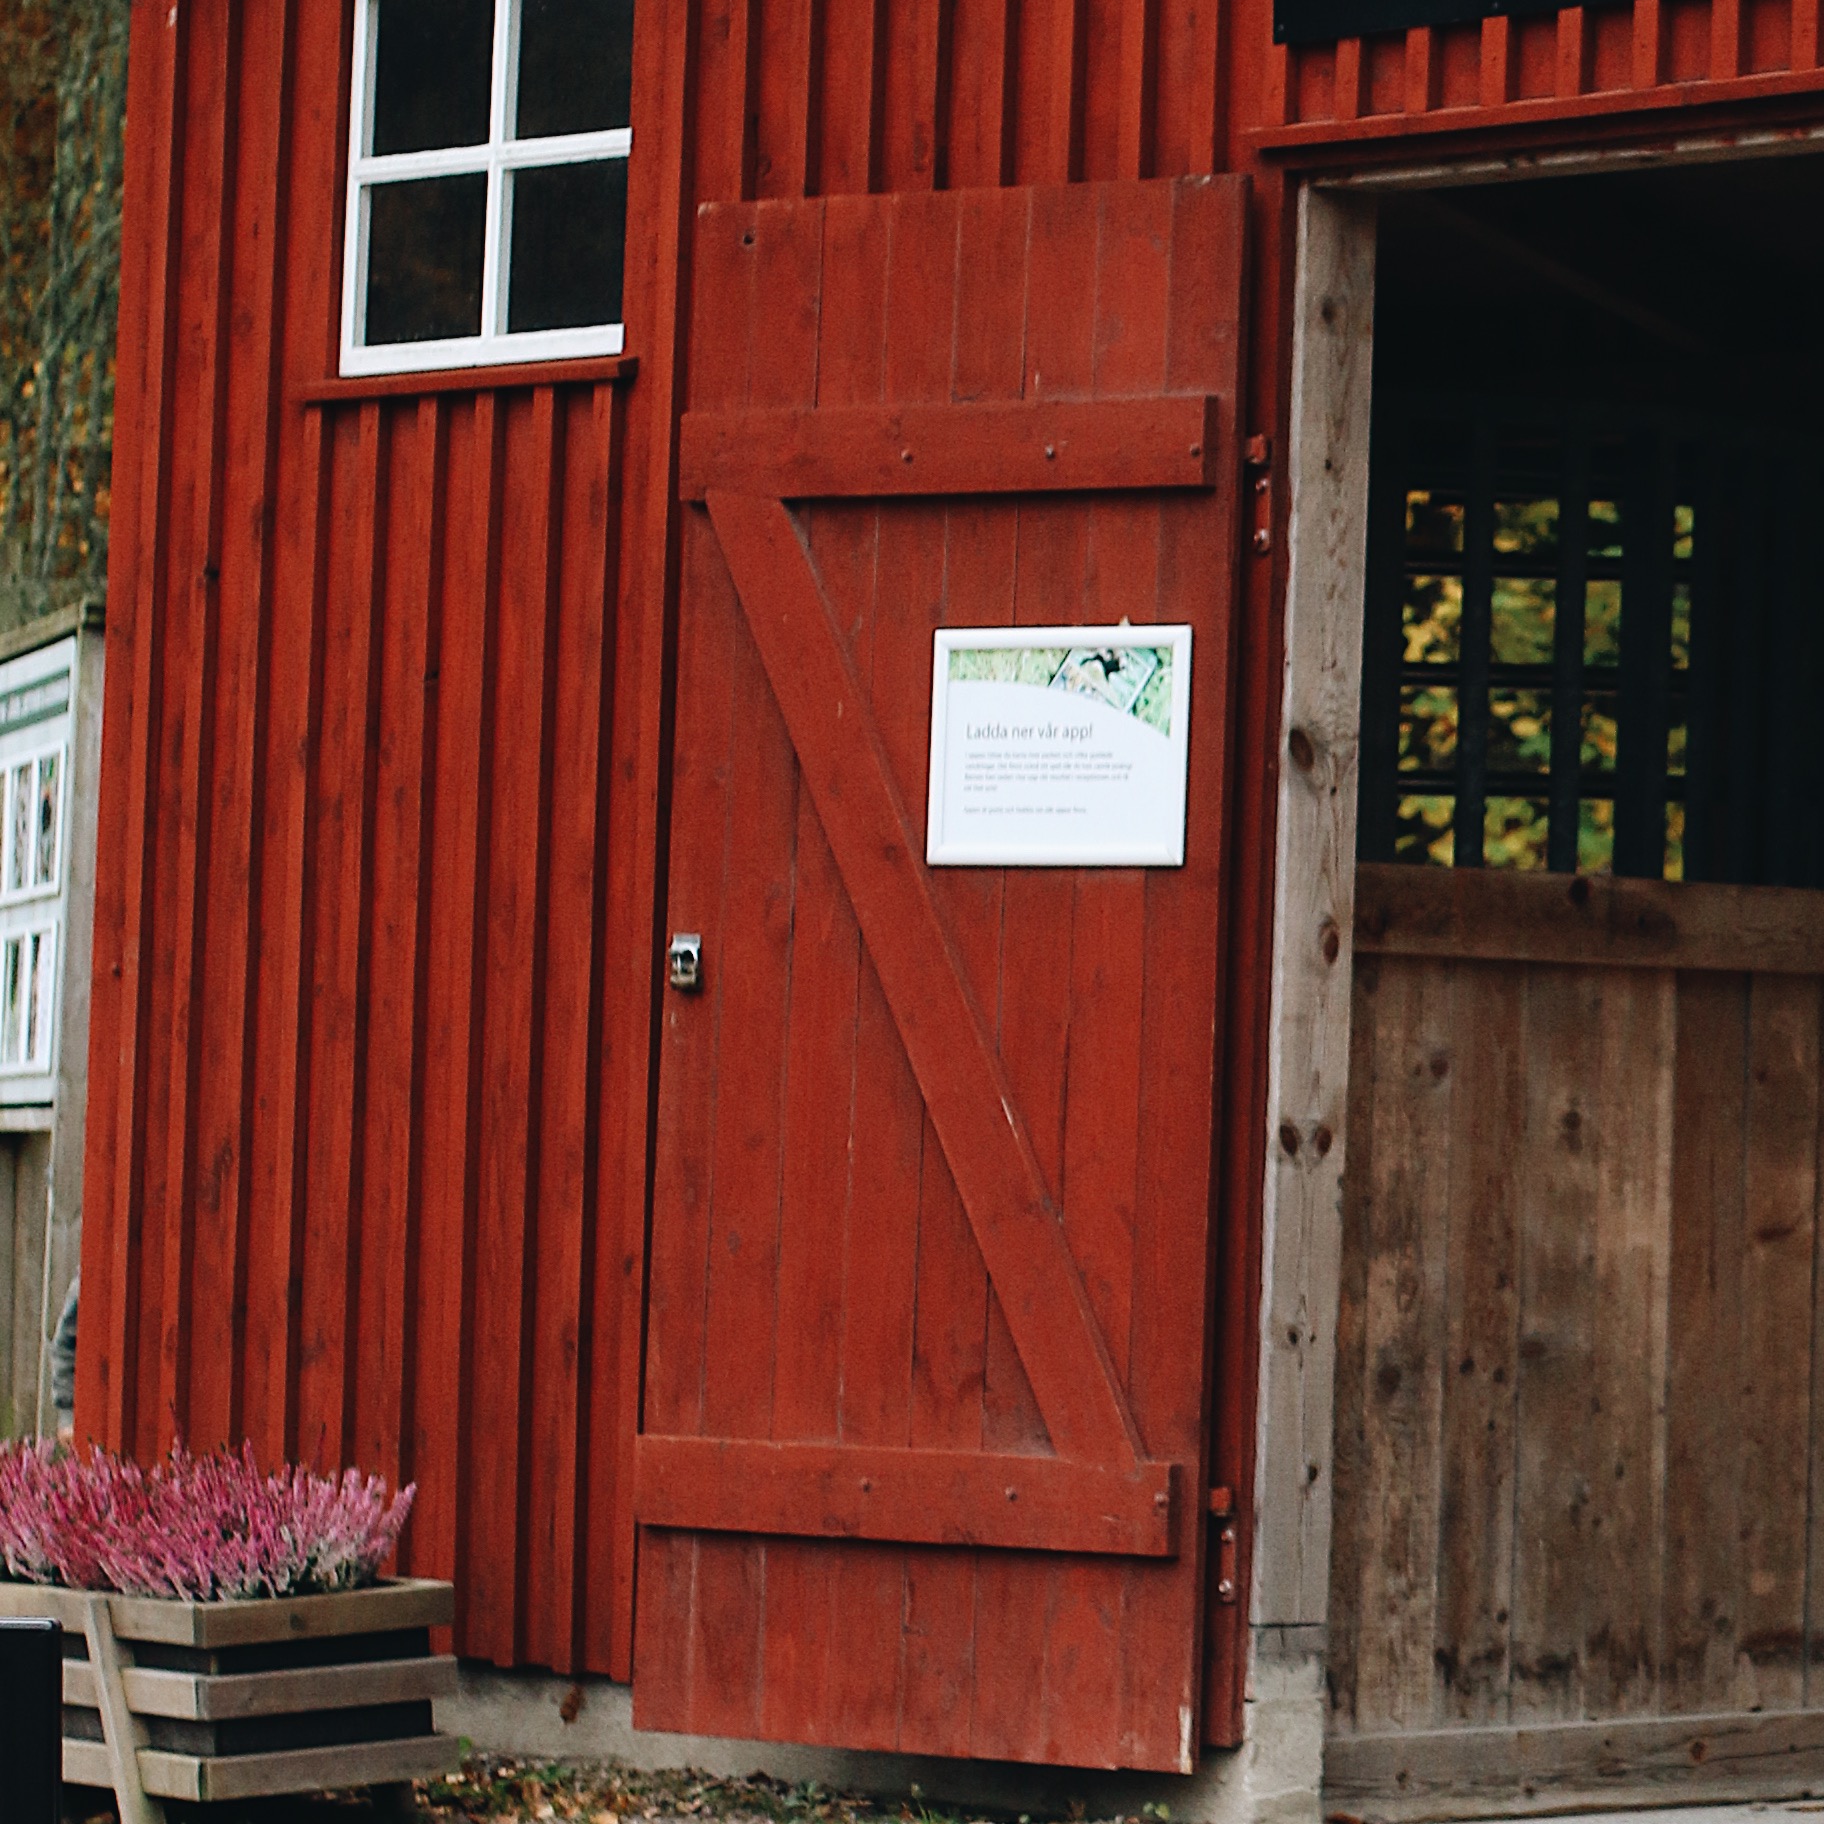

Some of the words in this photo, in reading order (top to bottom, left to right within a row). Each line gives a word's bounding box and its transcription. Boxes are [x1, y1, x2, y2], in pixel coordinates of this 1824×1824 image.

[966, 722, 1008, 740] Ladda
[1011, 726, 1034, 740] ner
[1037, 722, 1059, 740] vår
[1062, 722, 1093, 743] app!
